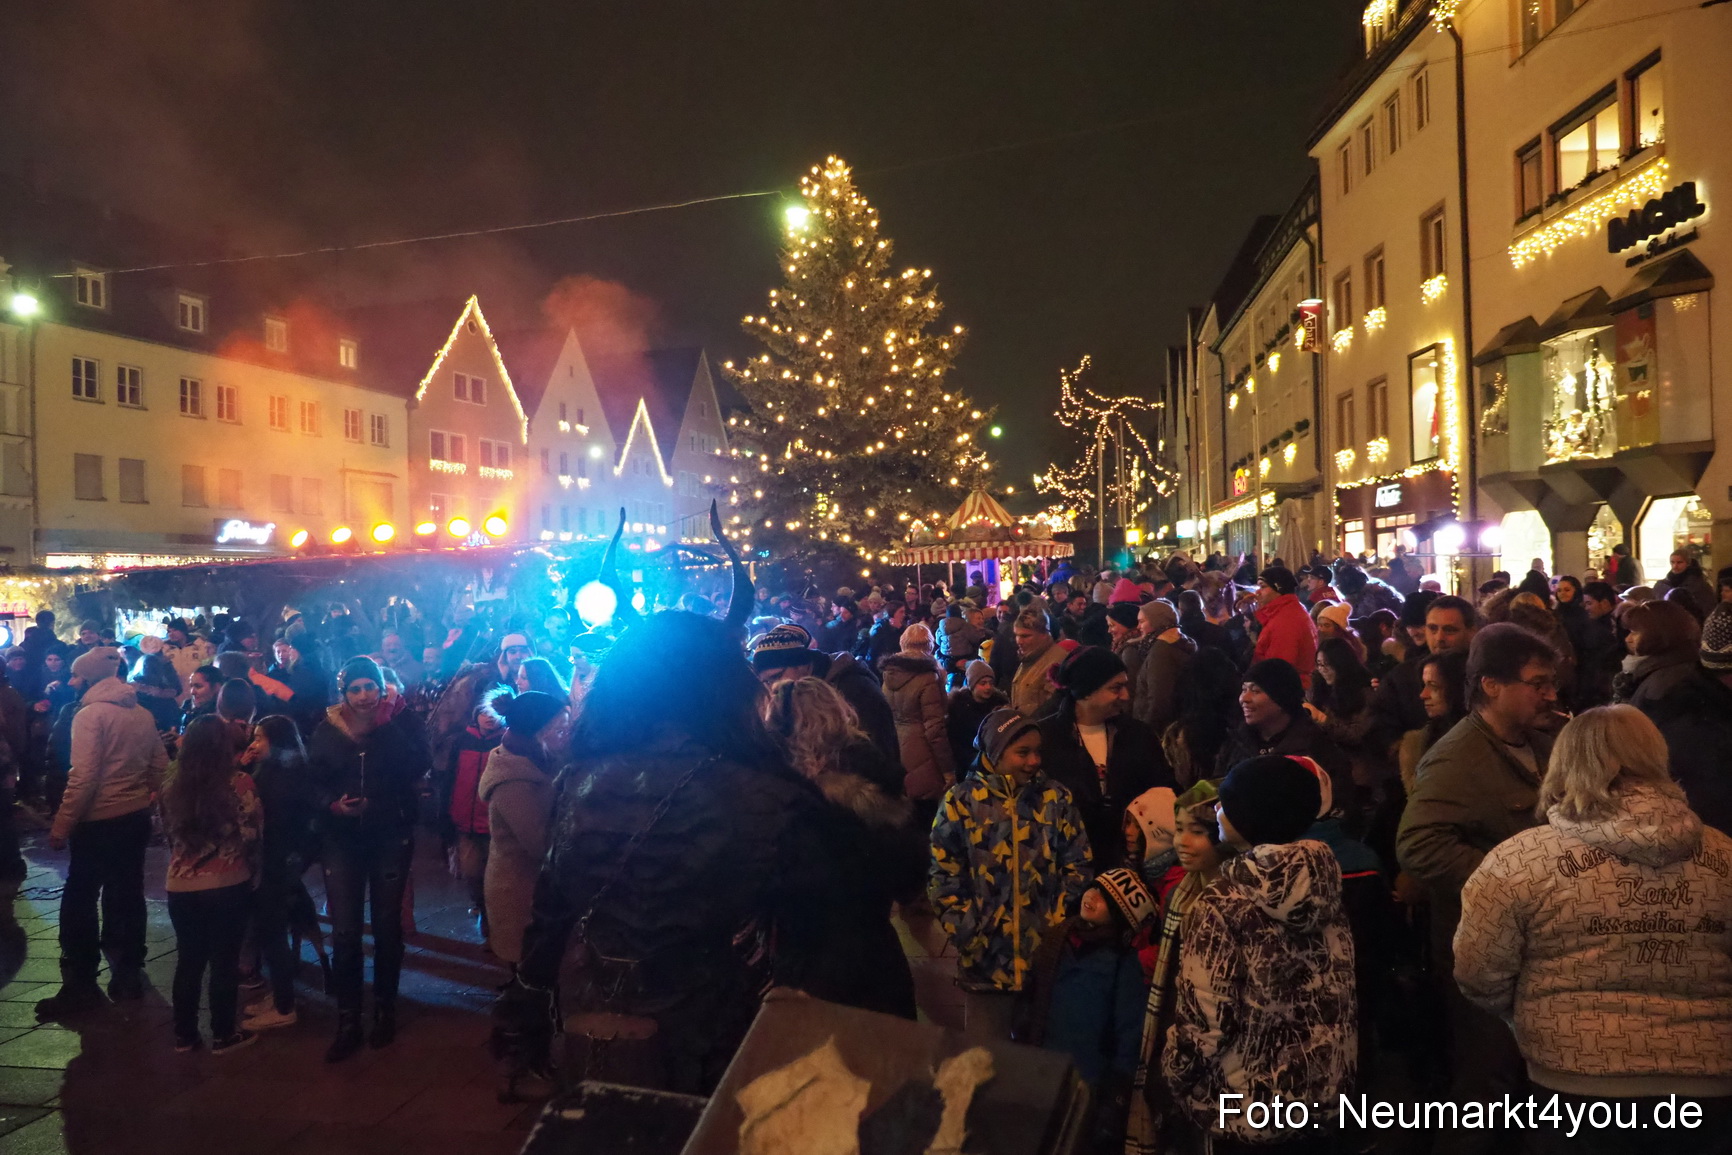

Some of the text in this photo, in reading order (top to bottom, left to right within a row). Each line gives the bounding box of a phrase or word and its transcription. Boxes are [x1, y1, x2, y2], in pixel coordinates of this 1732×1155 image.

[1303, 310, 1318, 348] Achatz
[1616, 876, 1694, 910] Kenji
[1587, 911, 1687, 936] Association
[1636, 938, 1690, 965] 1971
